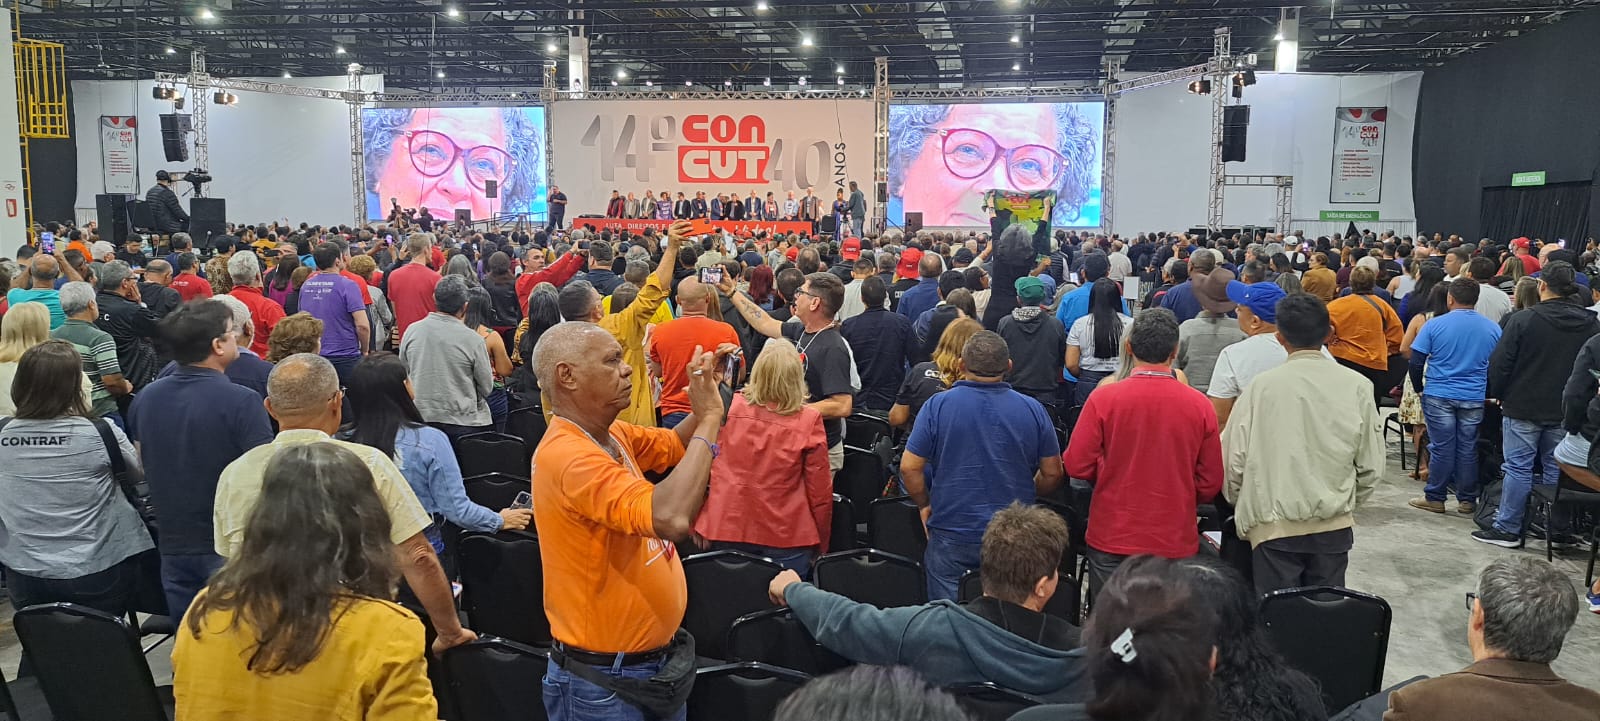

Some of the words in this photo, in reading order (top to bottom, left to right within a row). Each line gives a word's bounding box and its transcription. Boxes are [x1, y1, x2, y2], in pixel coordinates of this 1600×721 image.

[682, 150, 765, 179] CUT
[765, 138, 830, 192] 40
[835, 142, 846, 187] ANOS
